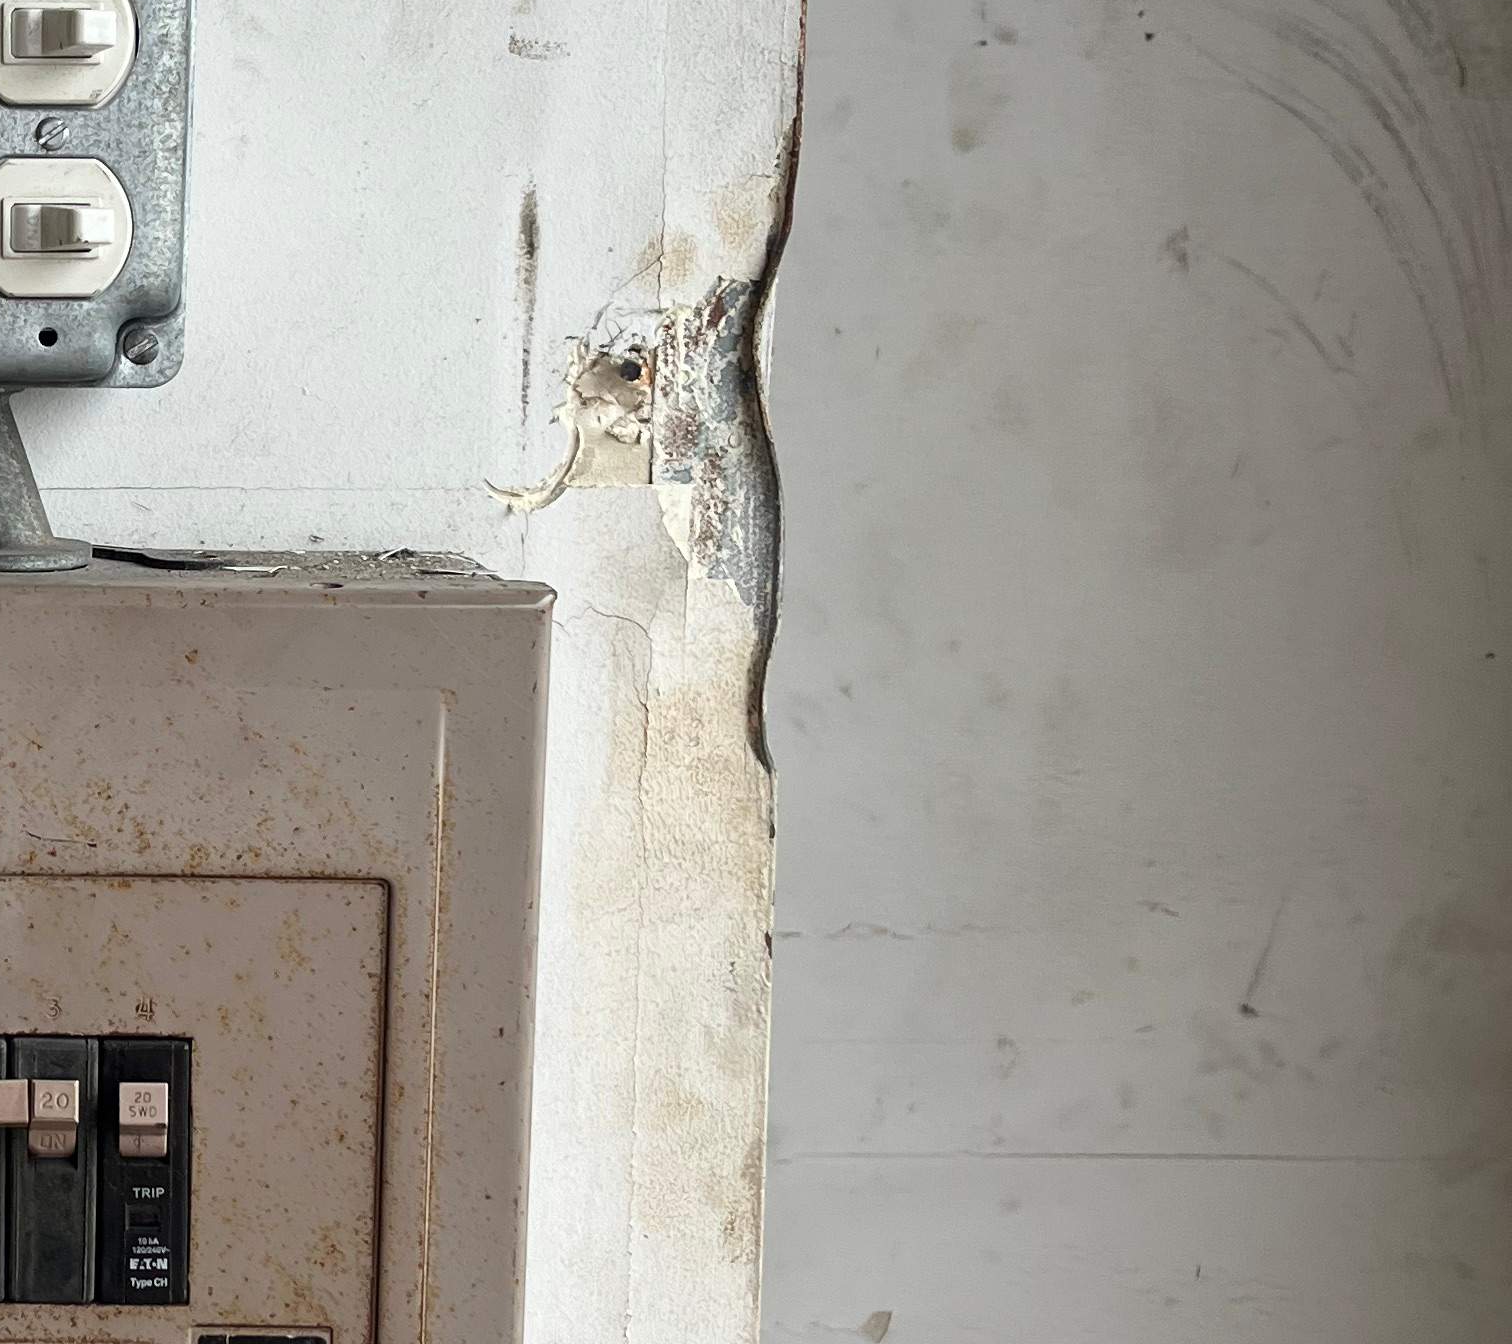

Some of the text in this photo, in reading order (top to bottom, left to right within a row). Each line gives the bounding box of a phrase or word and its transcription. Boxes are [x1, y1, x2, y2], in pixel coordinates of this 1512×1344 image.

[135, 995, 158, 1023] 4
[41, 1091, 70, 1110] 20
[134, 1092, 152, 1104] 20
[128, 1106, 157, 1118] SWD
[39, 1133, 67, 1151] ON
[132, 1187, 165, 1199] TRIP
[130, 1277, 168, 1290] Type CH
